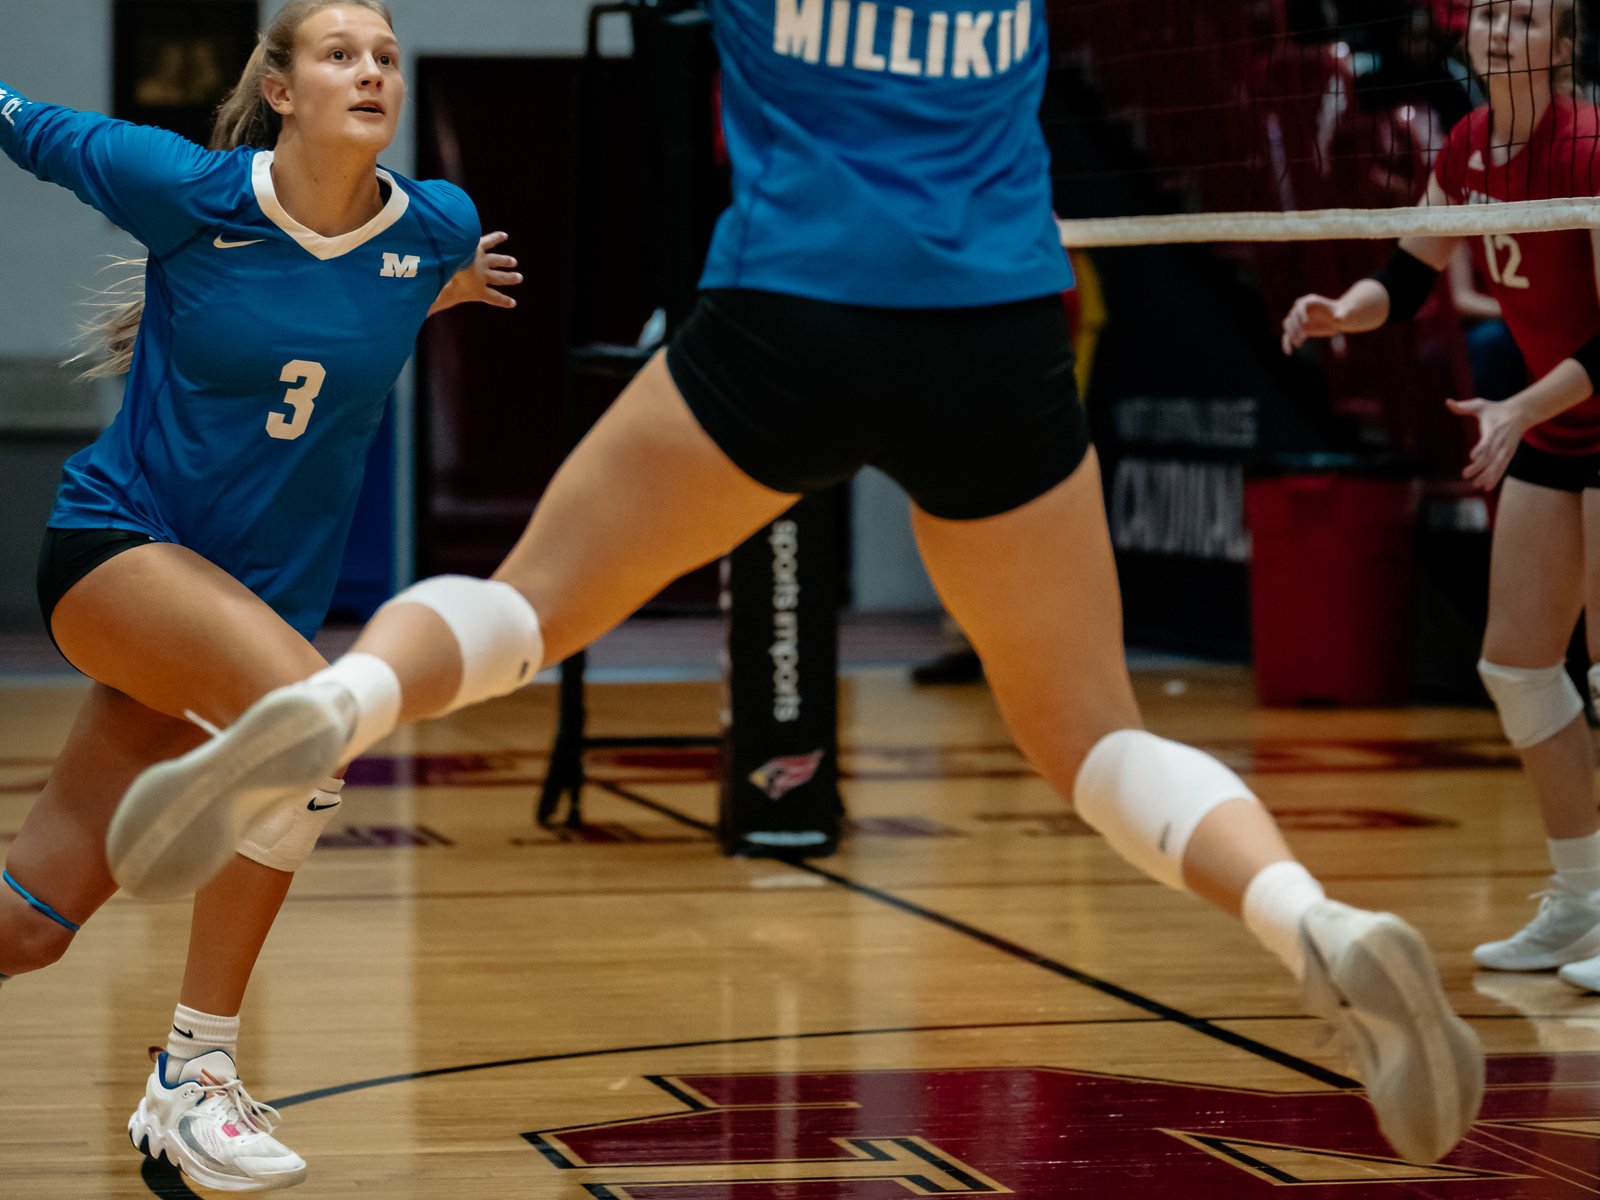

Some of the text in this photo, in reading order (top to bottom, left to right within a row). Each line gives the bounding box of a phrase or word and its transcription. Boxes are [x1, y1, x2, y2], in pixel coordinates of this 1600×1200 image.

[379, 252, 421, 278] M
[1482, 234, 1530, 289] 12
[265, 359, 326, 440] 3
[769, 519, 801, 611] sports
